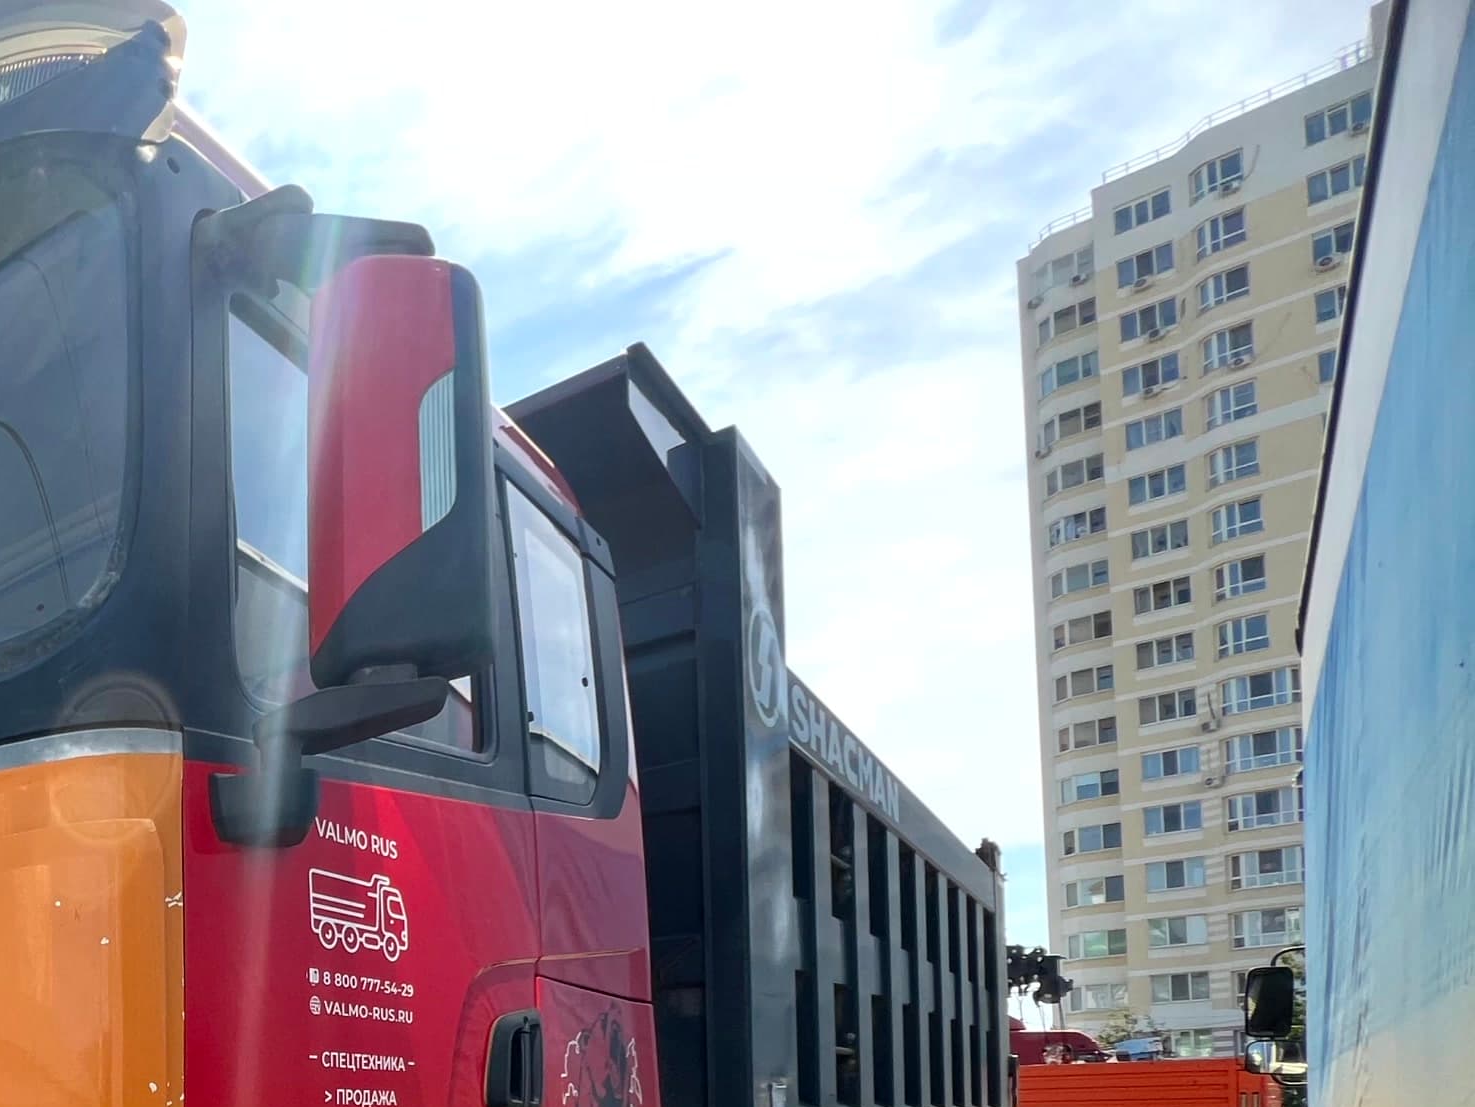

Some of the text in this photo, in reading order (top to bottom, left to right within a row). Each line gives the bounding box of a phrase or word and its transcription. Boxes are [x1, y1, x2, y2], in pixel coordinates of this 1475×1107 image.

[791, 684, 900, 823] SHACMAN
[315, 816, 398, 859] VALMO RUS
[323, 971, 414, 997] 8 800 777-54-29
[324, 1000, 413, 1023] VALMO-RUS.RU
[336, 1088, 397, 1107] ПРОДАЖА
